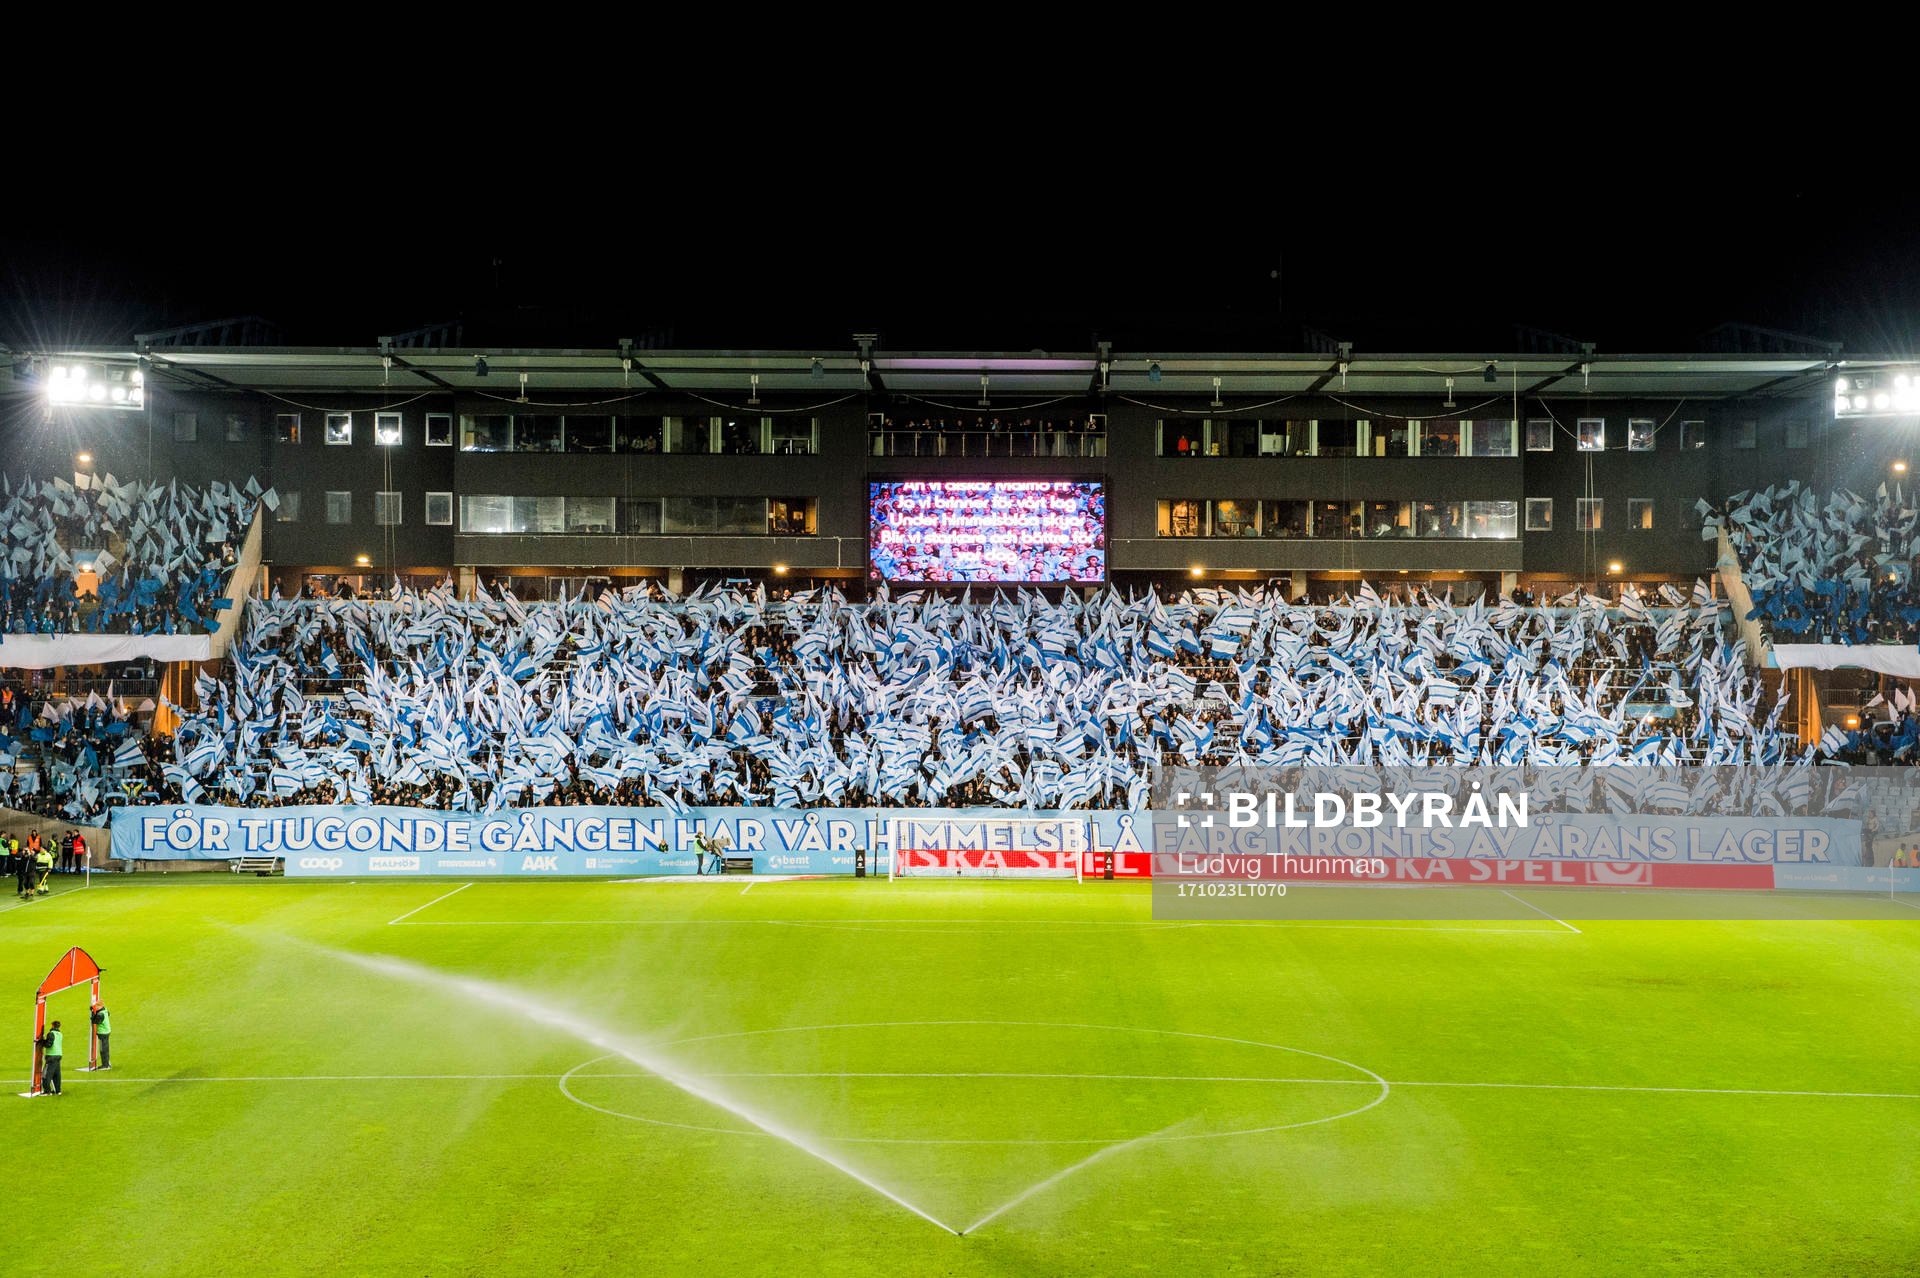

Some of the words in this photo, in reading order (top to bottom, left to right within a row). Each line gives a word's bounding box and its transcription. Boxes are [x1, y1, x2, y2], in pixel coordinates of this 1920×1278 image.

[918, 495, 931, 508] vi
[935, 495, 988, 508] brinner
[890, 513, 939, 526] Under
[908, 530, 921, 543] vi
[990, 530, 1018, 543] och
[142, 809, 230, 851] FÖR
[238, 817, 472, 852] TJUGONDE
[480, 812, 665, 852] GÅNGEN
[675, 818, 767, 852] HAR
[771, 812, 857, 852] VÅR
[865, 814, 1144, 853] HIMMELSBLÅ
[1152, 814, 1268, 854] FÄRG
[1275, 815, 1456, 859] KRÖNTS
[1465, 826, 1519, 859] AV
[1529, 815, 1678, 861] ÄRANS
[1686, 827, 1832, 864] LAGER
[299, 857, 343, 870] coop
[521, 855, 559, 871] AAK
